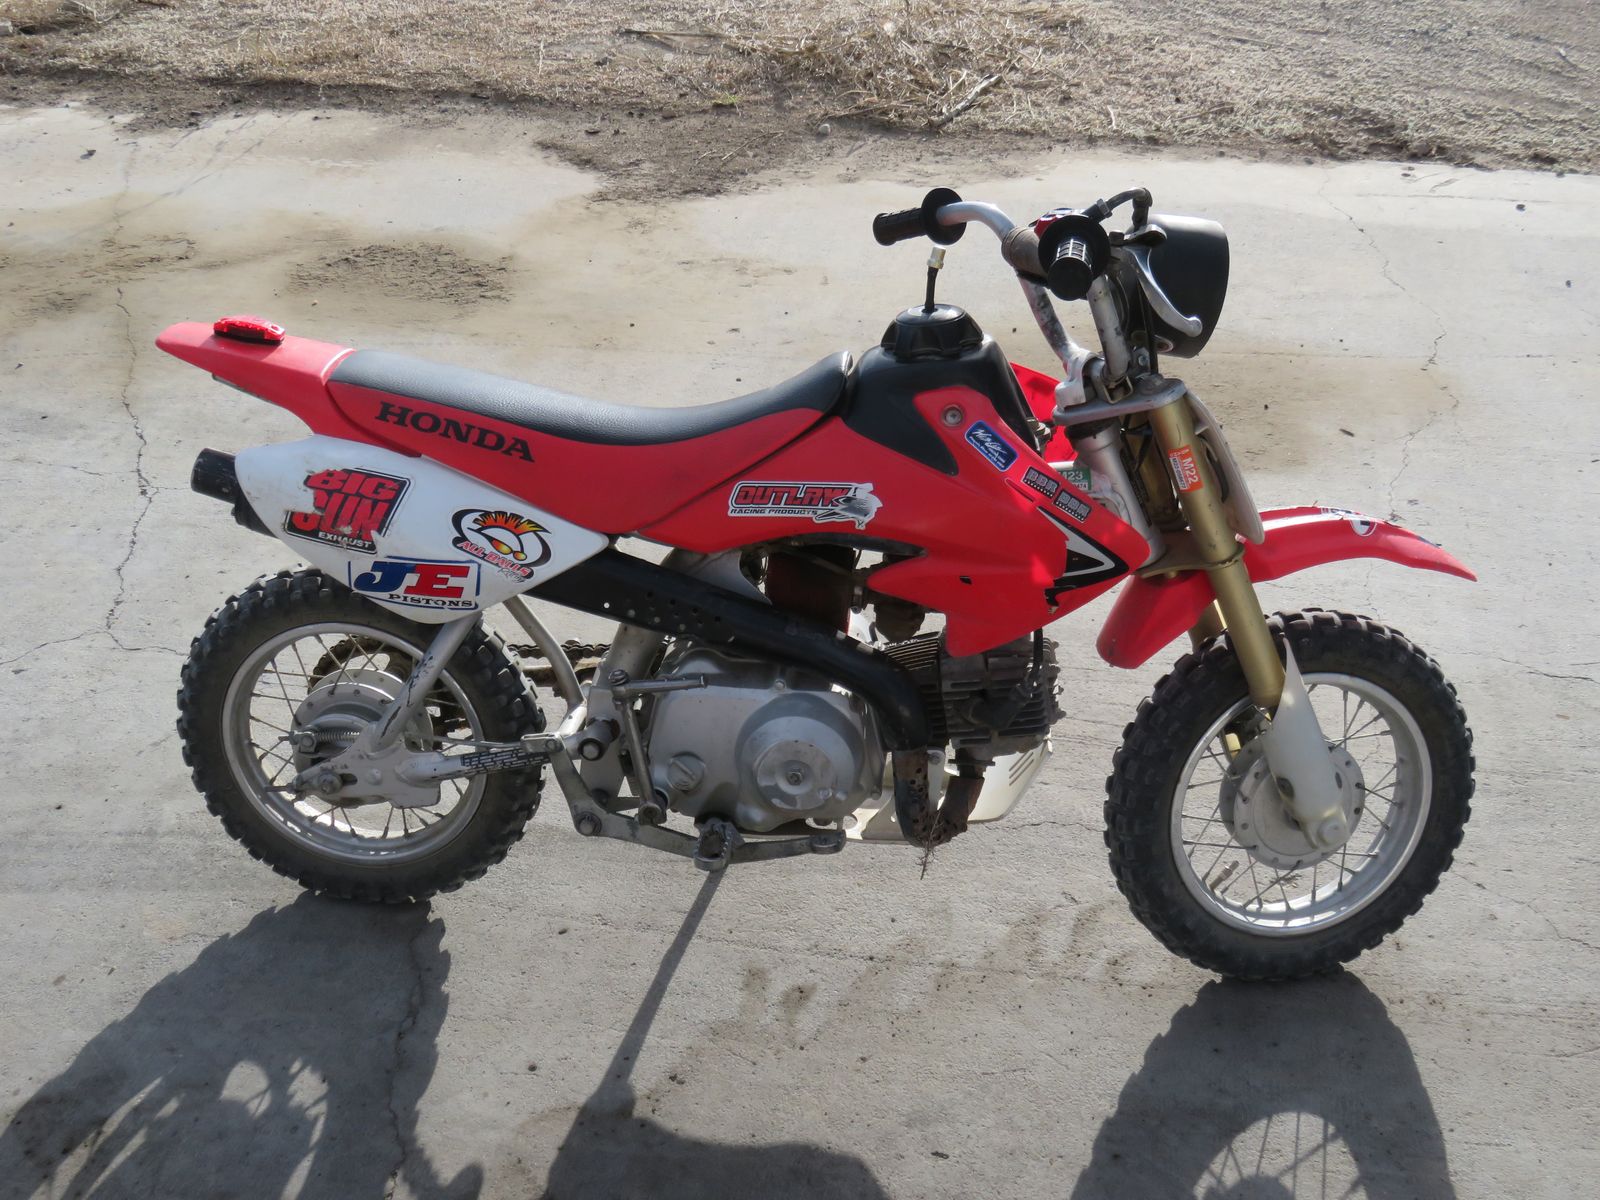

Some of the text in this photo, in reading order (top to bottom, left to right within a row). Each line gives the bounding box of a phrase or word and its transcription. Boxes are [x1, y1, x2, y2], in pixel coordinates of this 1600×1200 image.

[374, 400, 535, 462] HONDA
[1182, 457, 1198, 483] M22
[306, 468, 400, 501] BIG
[735, 485, 851, 507] OUTLAW
[768, 508, 818, 516] PRODUCTS
[318, 531, 373, 549] EXHAUST
[457, 540, 532, 577] ALL BALLS
[352, 560, 470, 598] JE
[387, 592, 474, 609] PISTONS
